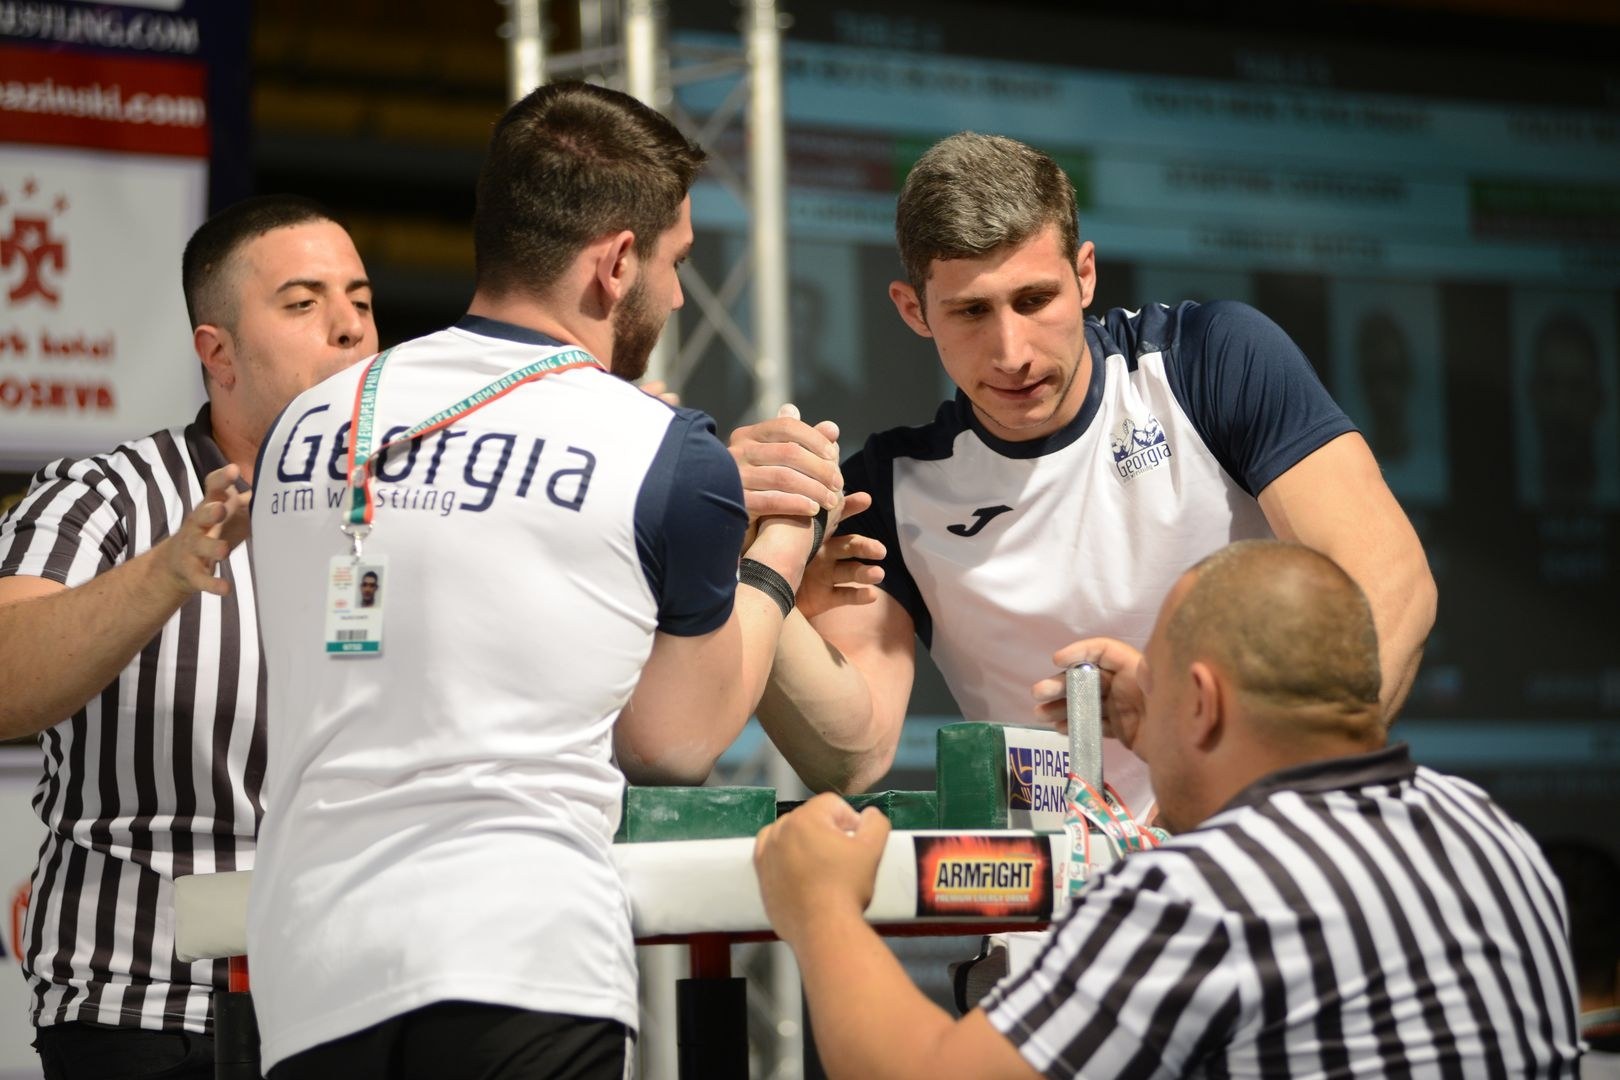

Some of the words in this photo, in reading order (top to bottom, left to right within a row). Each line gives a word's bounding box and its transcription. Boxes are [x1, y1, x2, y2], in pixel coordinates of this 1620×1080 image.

[0, 79, 205, 126] azinski.com
[0, 379, 114, 411] OSKVA
[469, 357, 554, 407] ARMWRESTLING
[357, 391, 376, 436] EUROPEAN
[276, 403, 597, 513] Georgia
[1116, 443, 1172, 478] Georgia
[271, 488, 314, 515] arm
[327, 486, 456, 517] wstling
[1034, 749, 1070, 778] PIRAE
[1034, 785, 1068, 813] BANK
[937, 862, 1033, 888] ARMFIGHT
